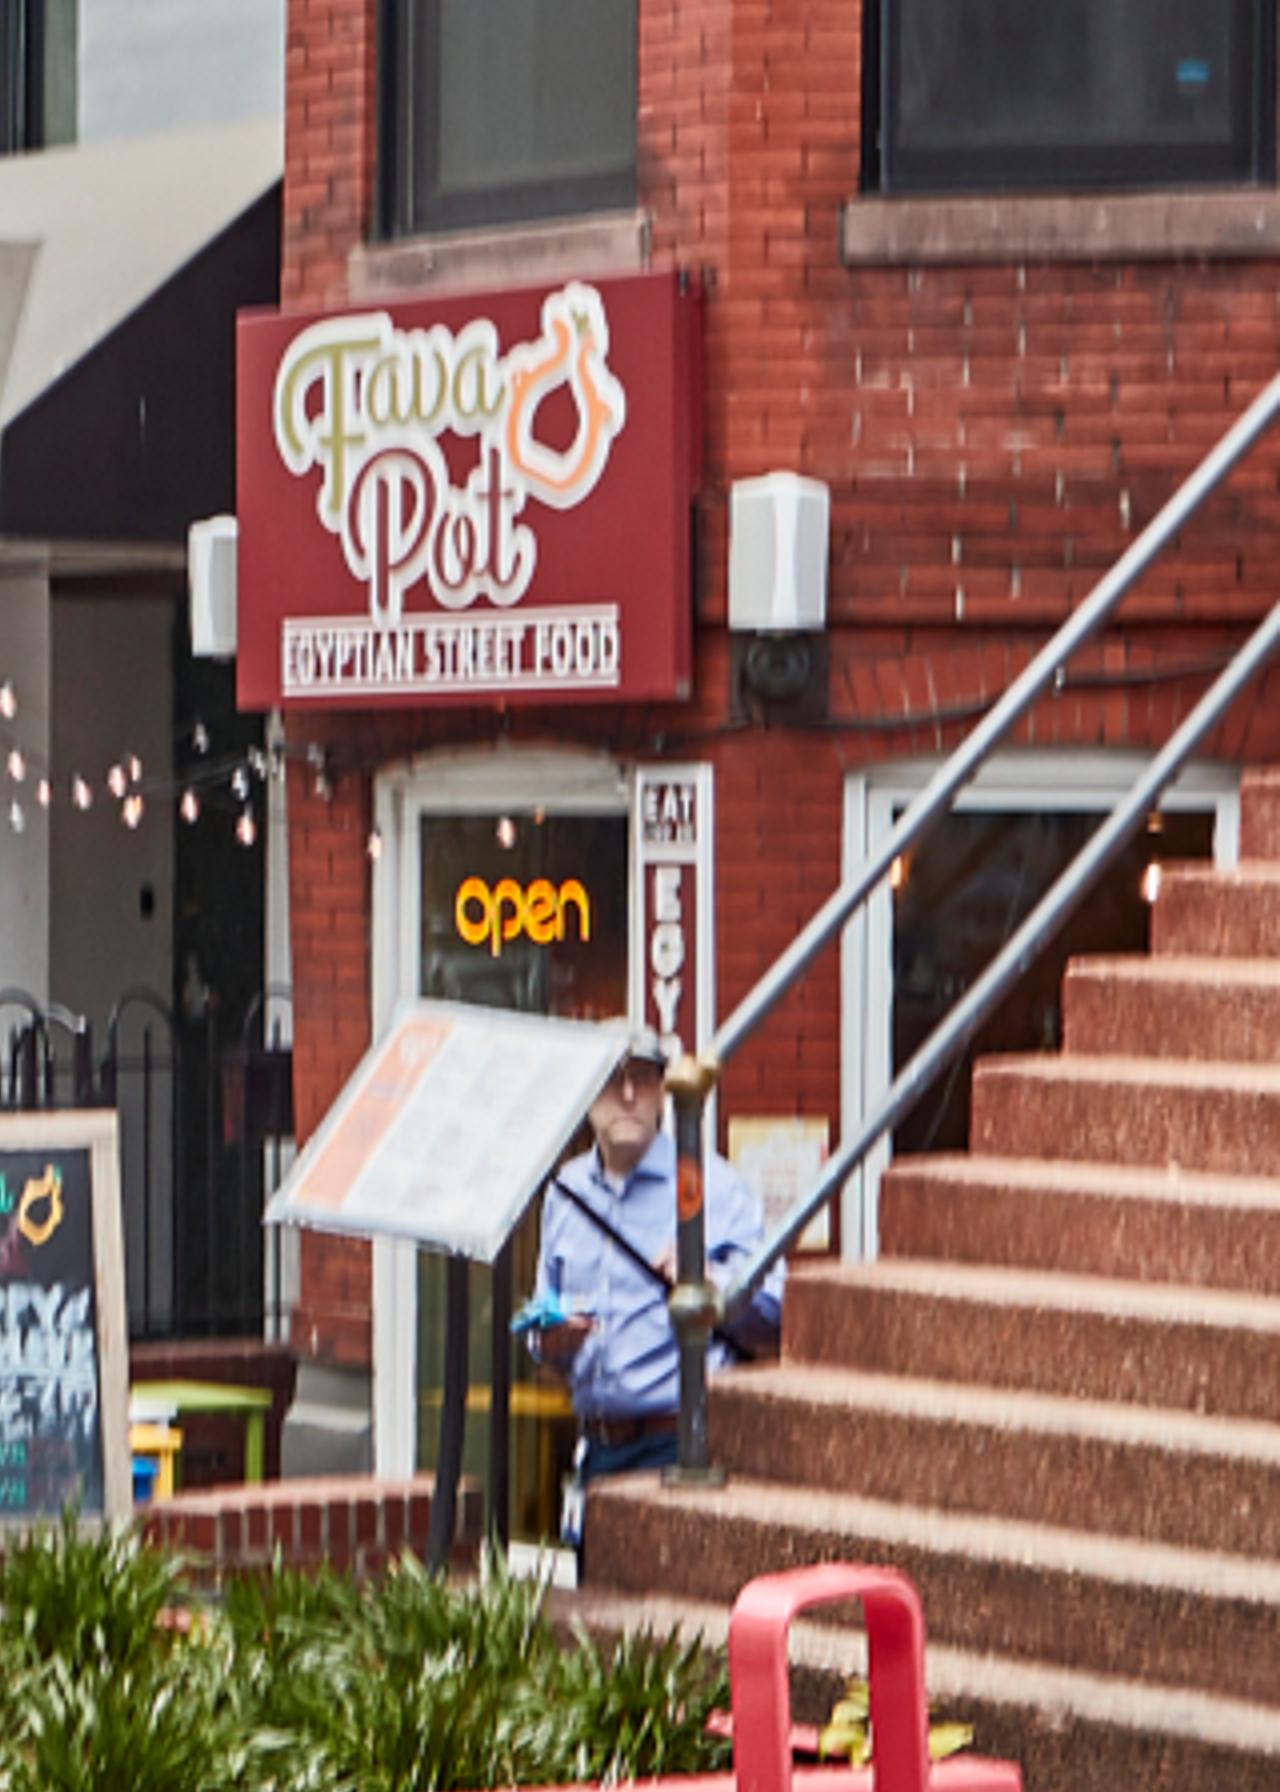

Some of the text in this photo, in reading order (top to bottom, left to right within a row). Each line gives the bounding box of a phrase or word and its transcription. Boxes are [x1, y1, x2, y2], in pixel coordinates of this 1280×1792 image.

[277, 320, 507, 523] Fava
[344, 440, 530, 618] Pot
[286, 617, 619, 686] EGYPTIAN STREET FOOD
[454, 876, 590, 958] open
